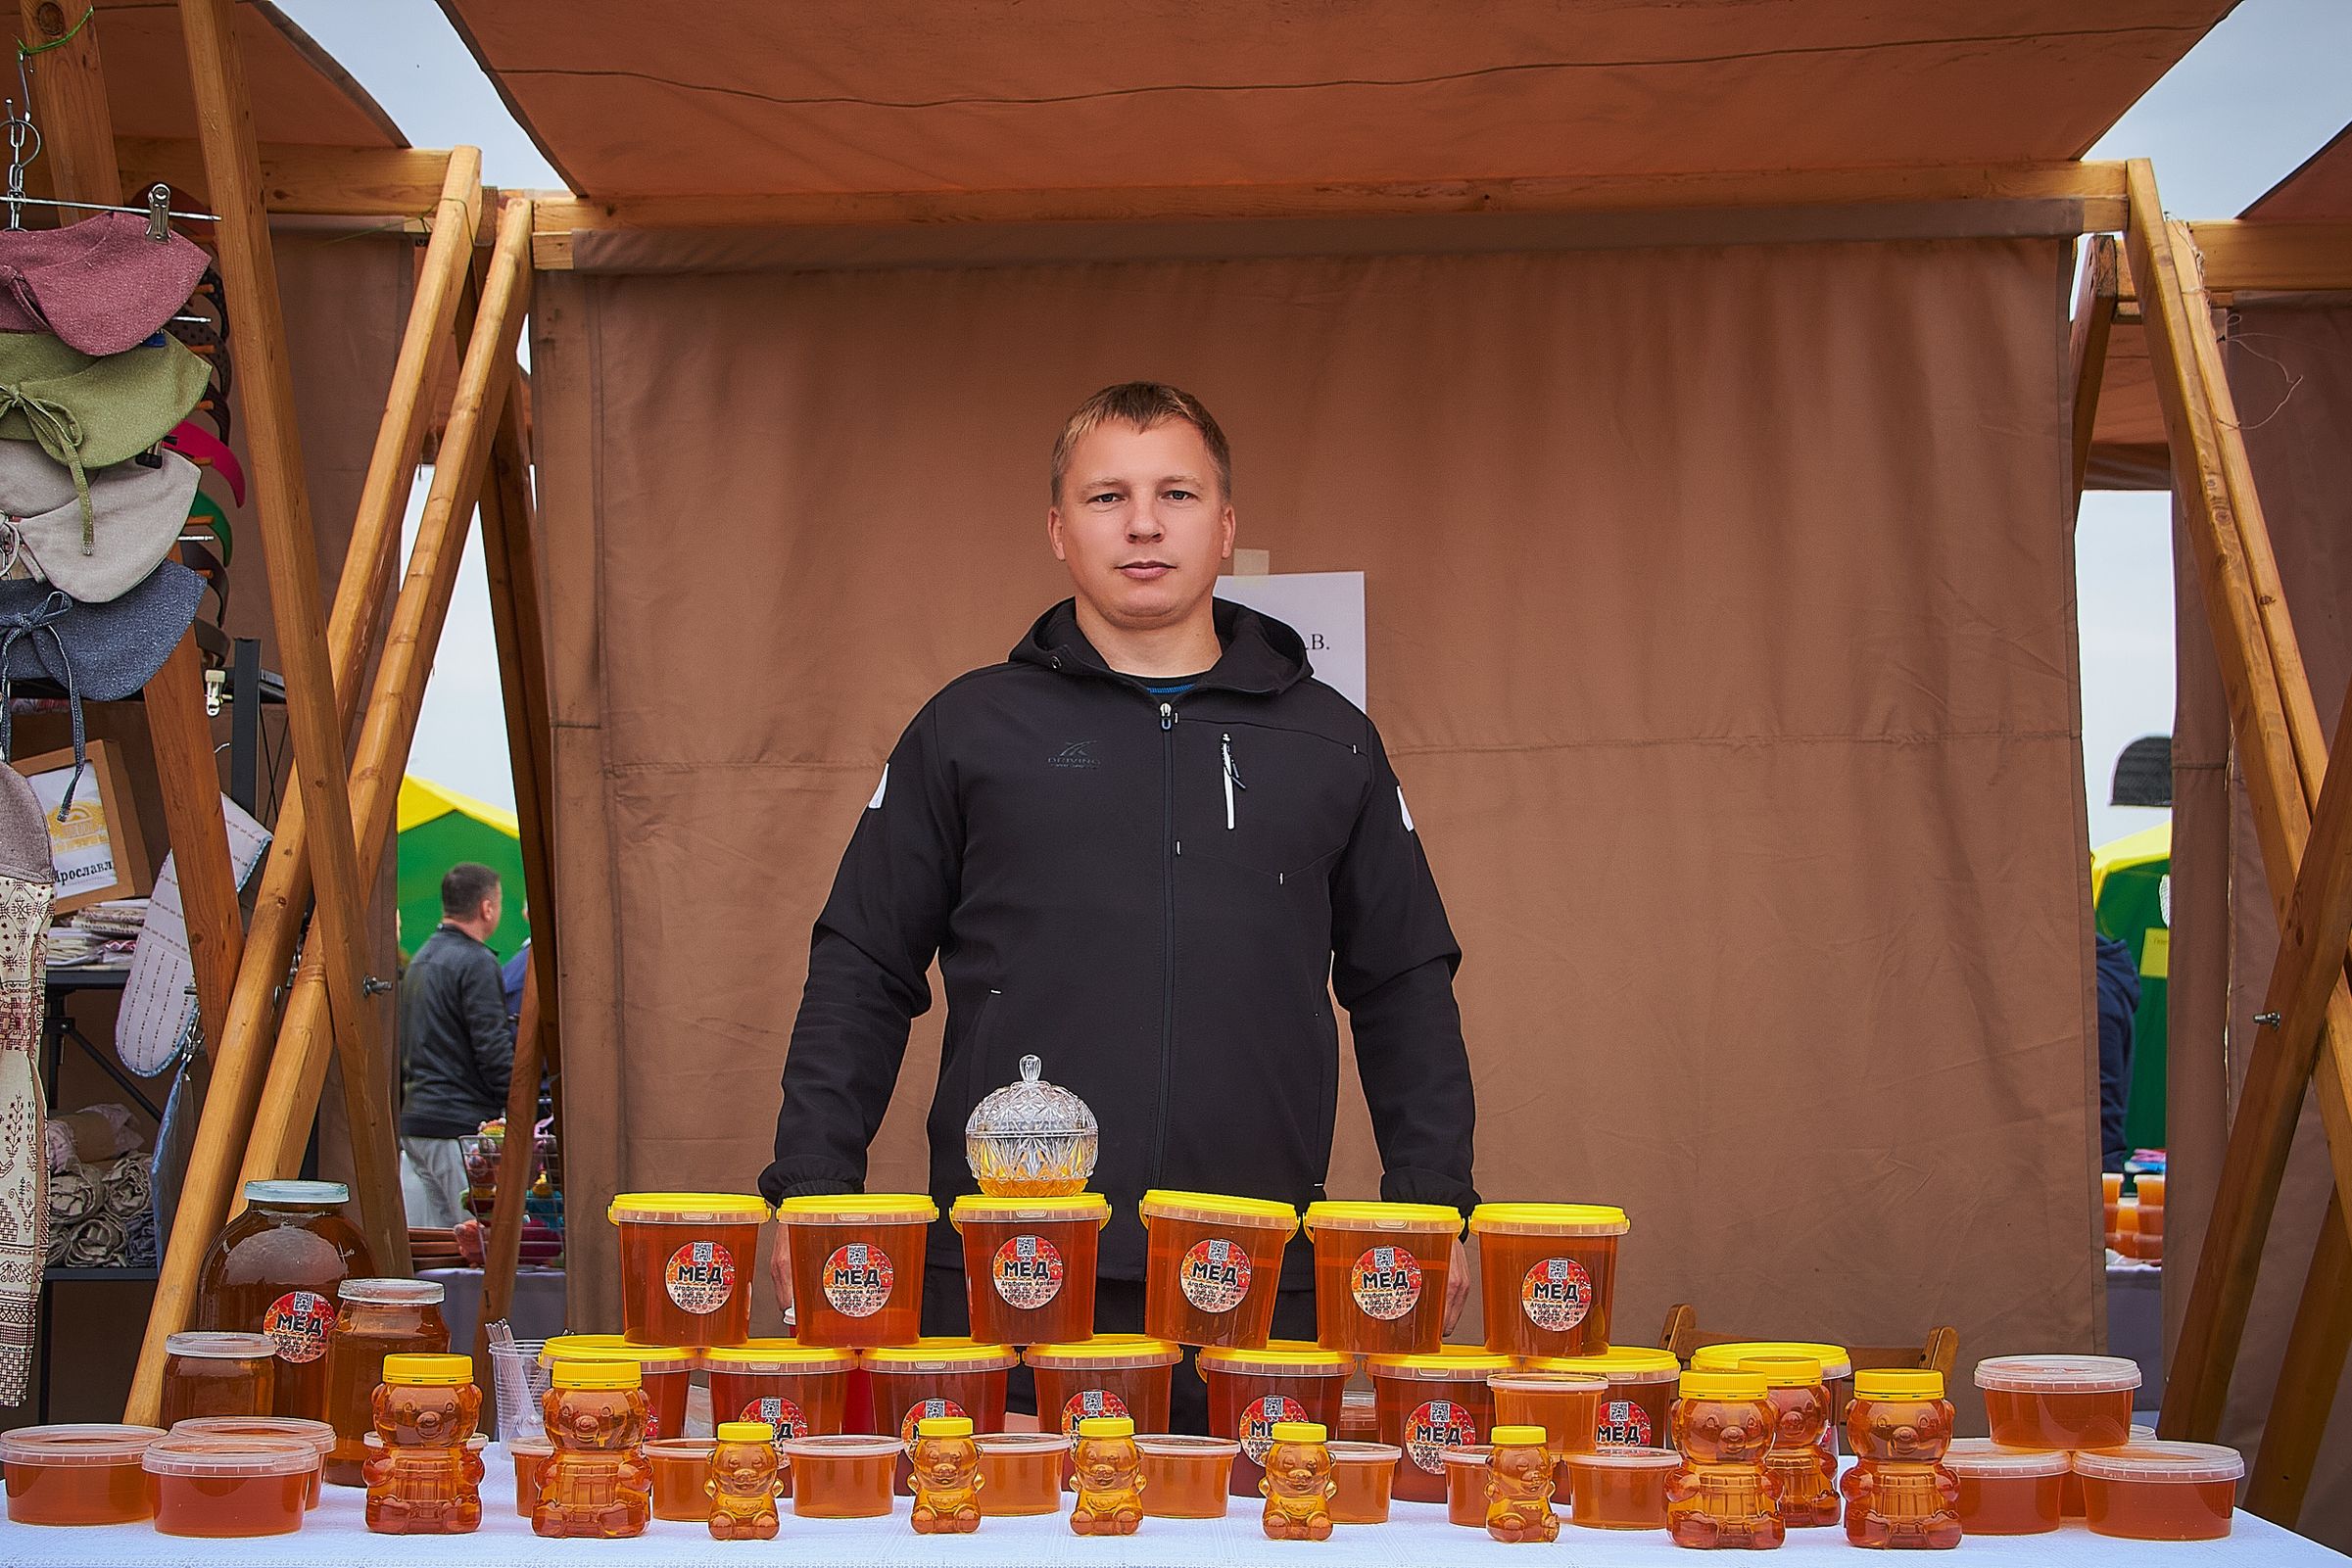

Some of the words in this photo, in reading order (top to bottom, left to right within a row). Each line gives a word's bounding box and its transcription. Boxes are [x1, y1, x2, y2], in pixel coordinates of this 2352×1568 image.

[678, 1261, 723, 1285] МЁД
[835, 1264, 880, 1288] МЁД
[1004, 1257, 1049, 1280] МЁД
[1192, 1260, 1237, 1286] МЁД
[1363, 1267, 1409, 1290] МЁД
[1533, 1279, 1579, 1303] МЁД
[1416, 1422, 1463, 1446] МЁД
